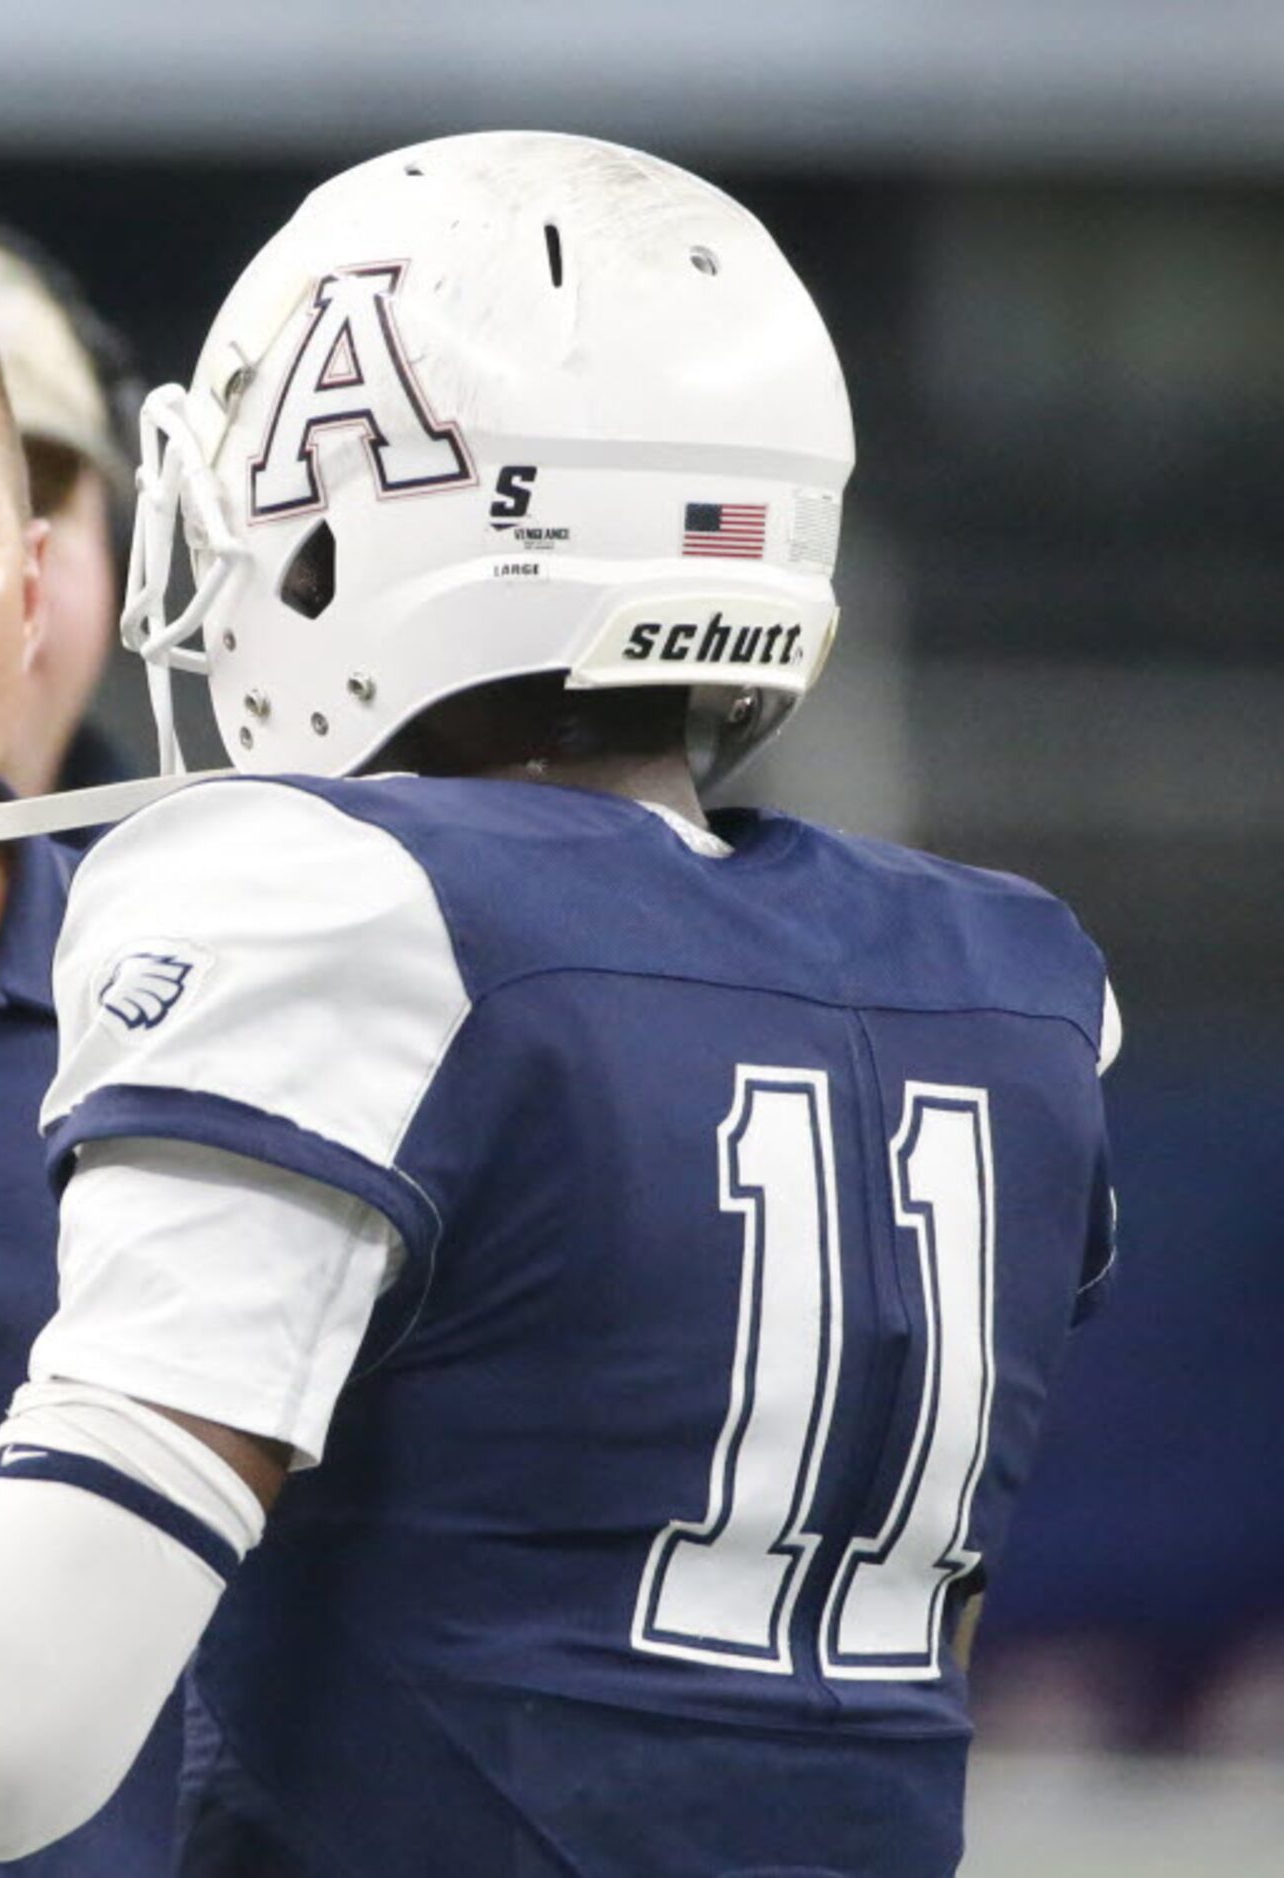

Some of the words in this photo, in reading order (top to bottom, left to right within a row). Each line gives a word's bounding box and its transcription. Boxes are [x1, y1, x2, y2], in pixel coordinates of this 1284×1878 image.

[247, 259, 479, 526] A
[490, 465, 537, 517] S
[514, 527, 570, 541] VENGEANCE
[493, 563, 539, 577] LARGE
[623, 611, 801, 664] schutt
[631, 1063, 996, 1681] 11
